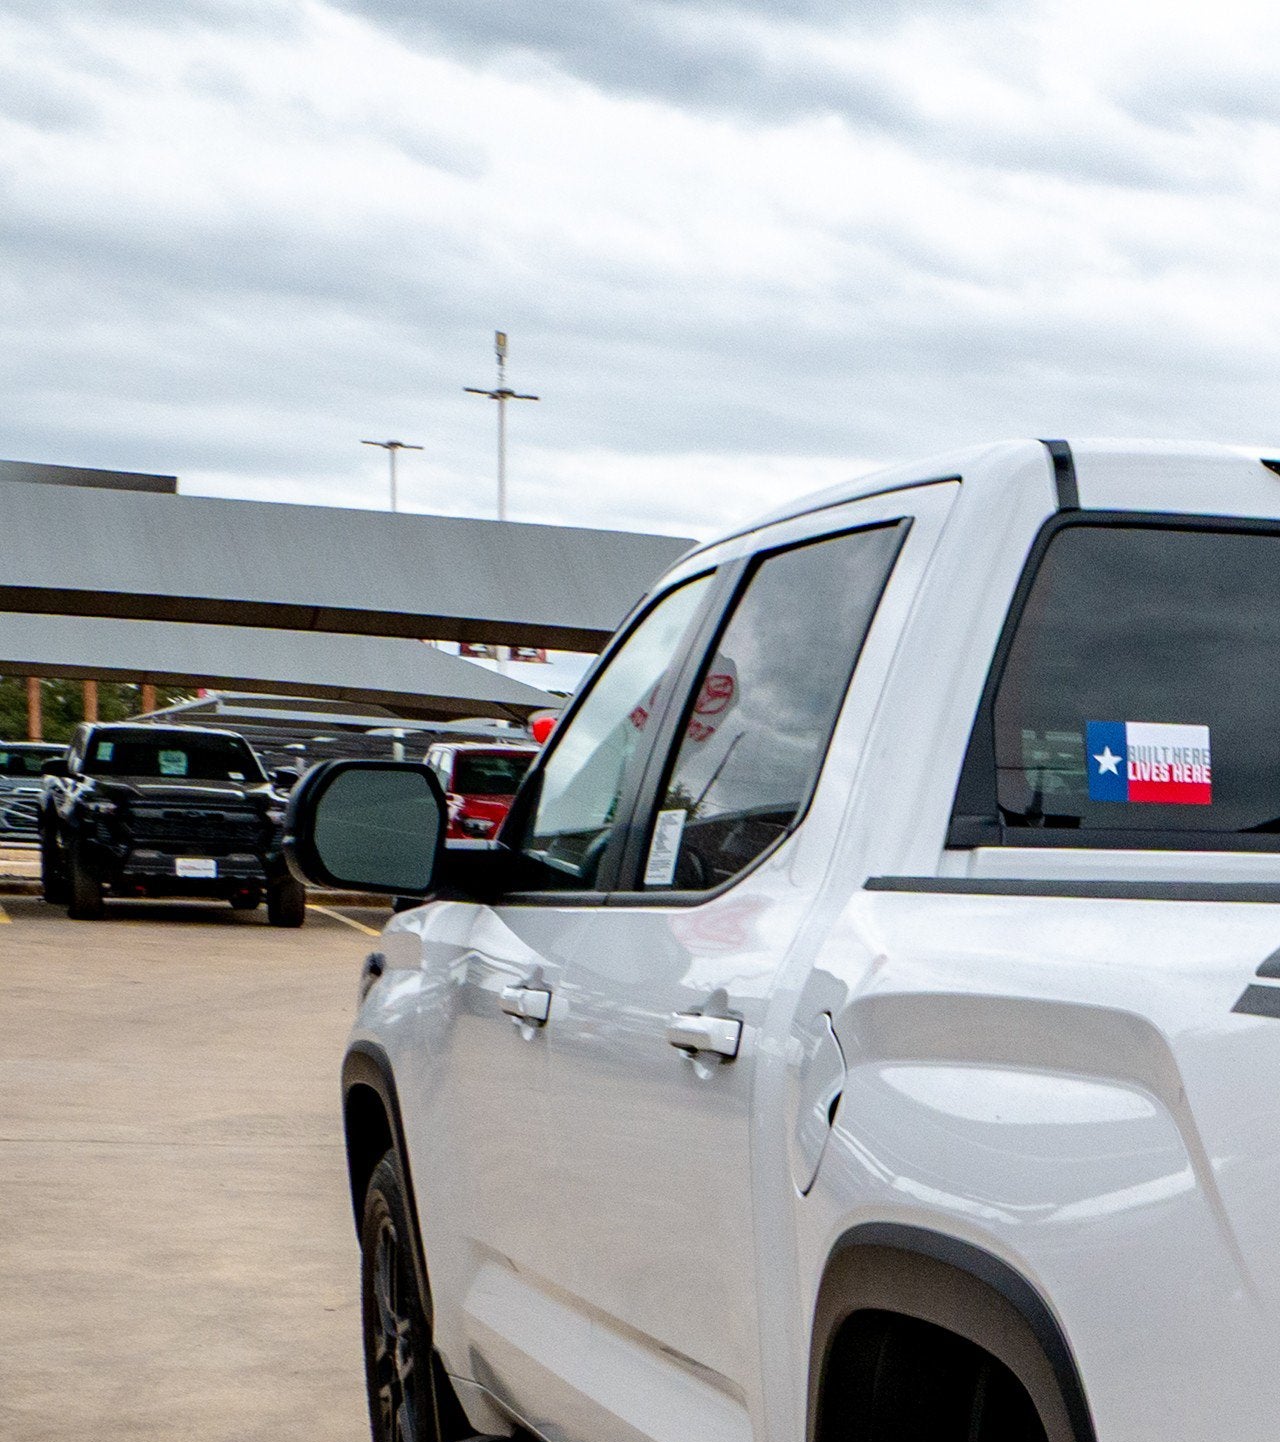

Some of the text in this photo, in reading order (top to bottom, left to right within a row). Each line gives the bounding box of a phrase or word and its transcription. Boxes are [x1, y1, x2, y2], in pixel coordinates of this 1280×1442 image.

[1127, 745, 1210, 766] BUILT HERE
[1127, 761, 1212, 784] LIVES HERE
